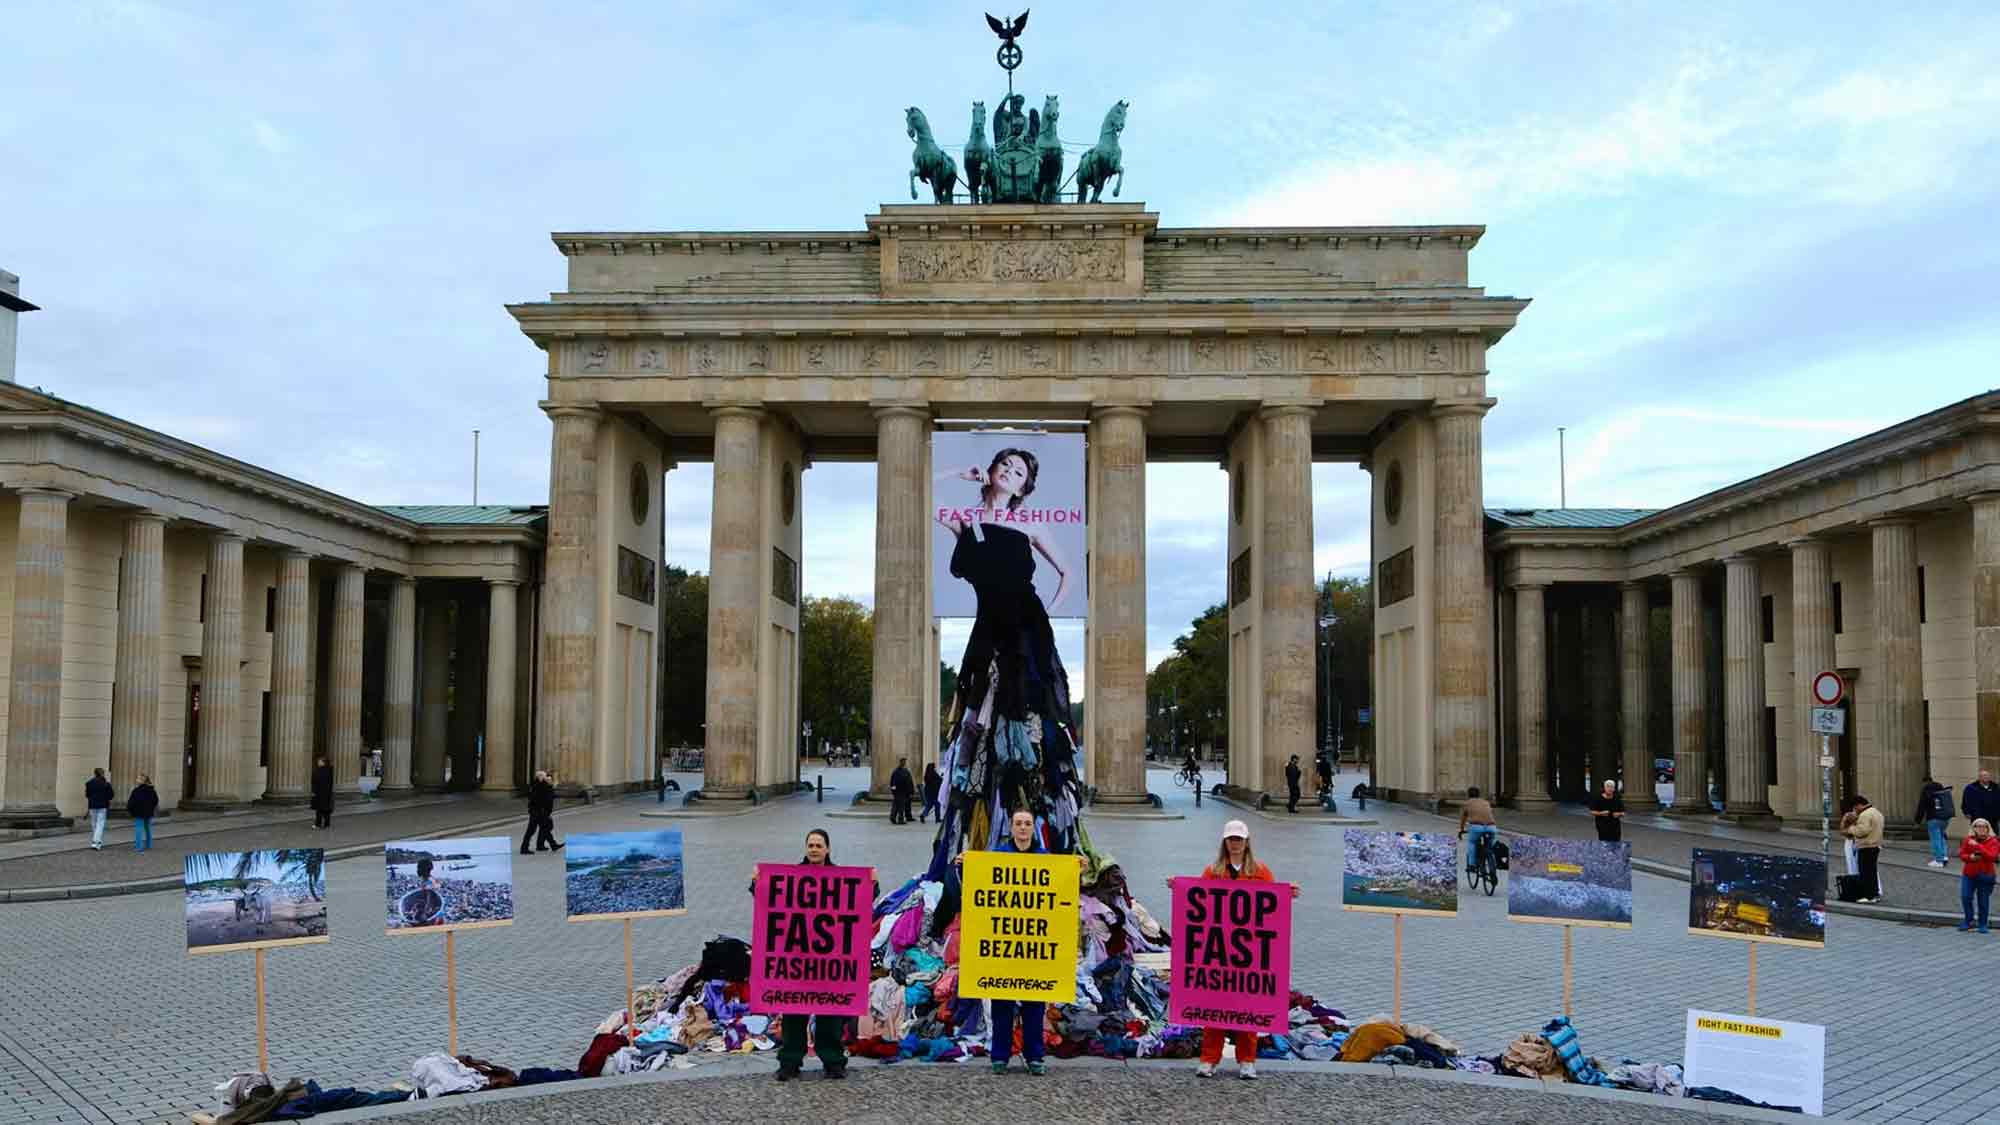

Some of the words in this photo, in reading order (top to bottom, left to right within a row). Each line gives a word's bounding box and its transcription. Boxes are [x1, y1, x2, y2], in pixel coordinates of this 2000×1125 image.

[939, 508, 985, 522] FAST
[994, 508, 1081, 522] FASHION
[992, 866, 1050, 887] BILLIG
[768, 874, 861, 910] FIGHT
[1186, 886, 1277, 927] STOP
[766, 912, 859, 955] FAST
[991, 916, 1048, 937] TEUER
[979, 939, 1058, 961] BEZAHLT
[1185, 924, 1277, 970] FAST
[764, 956, 858, 982] FASHION
[977, 976, 1058, 991] GREENPEACE
[1184, 966, 1276, 996] FASHION
[761, 989, 857, 1006] GREENPEACE
[1182, 1006, 1276, 1027] GREENPEACE
[1697, 1018, 1721, 1030] FIGHT
[1723, 1021, 1743, 1033] FAST
[1745, 1024, 1781, 1038] FASHION
